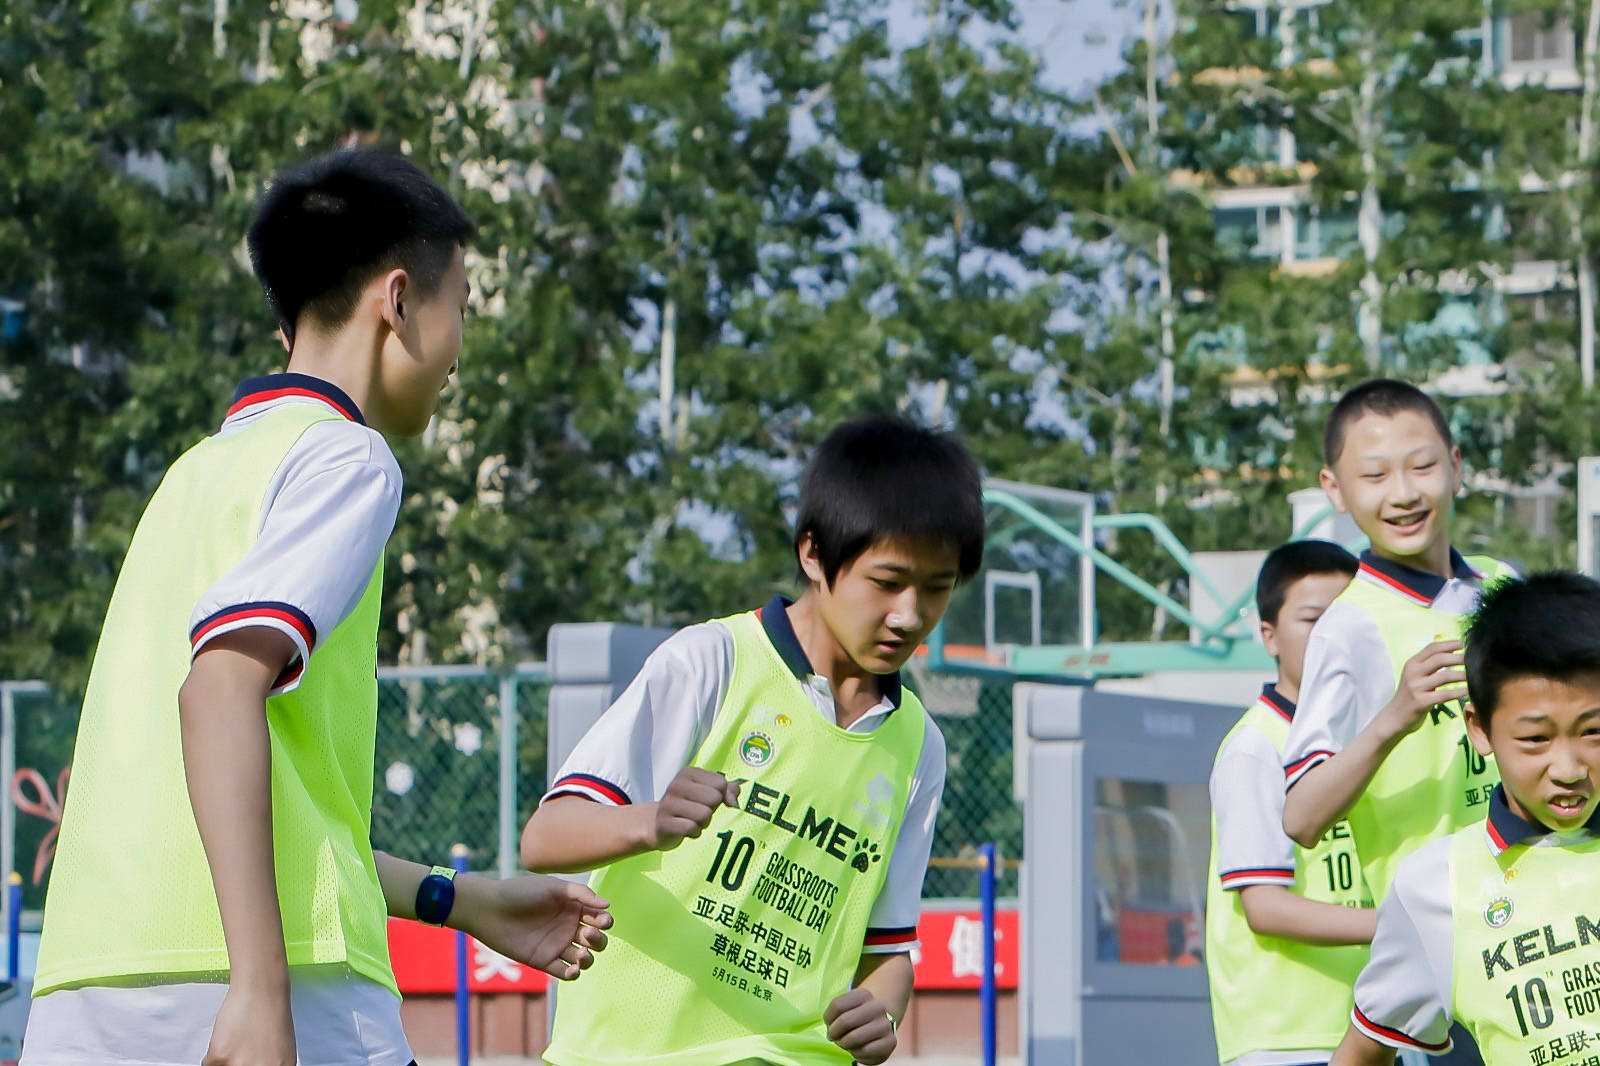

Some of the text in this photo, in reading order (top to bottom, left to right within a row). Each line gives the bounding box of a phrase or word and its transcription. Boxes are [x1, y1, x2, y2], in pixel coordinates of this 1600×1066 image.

[717, 771, 857, 862] ELME
[706, 830, 755, 891] 10
[766, 852, 839, 908] GRASSROOTS
[1321, 852, 1353, 892] 10
[752, 874, 832, 934] FOOTBALL DAY
[710, 933, 789, 988] 草根足球日
[1505, 977, 1554, 1038] 10
